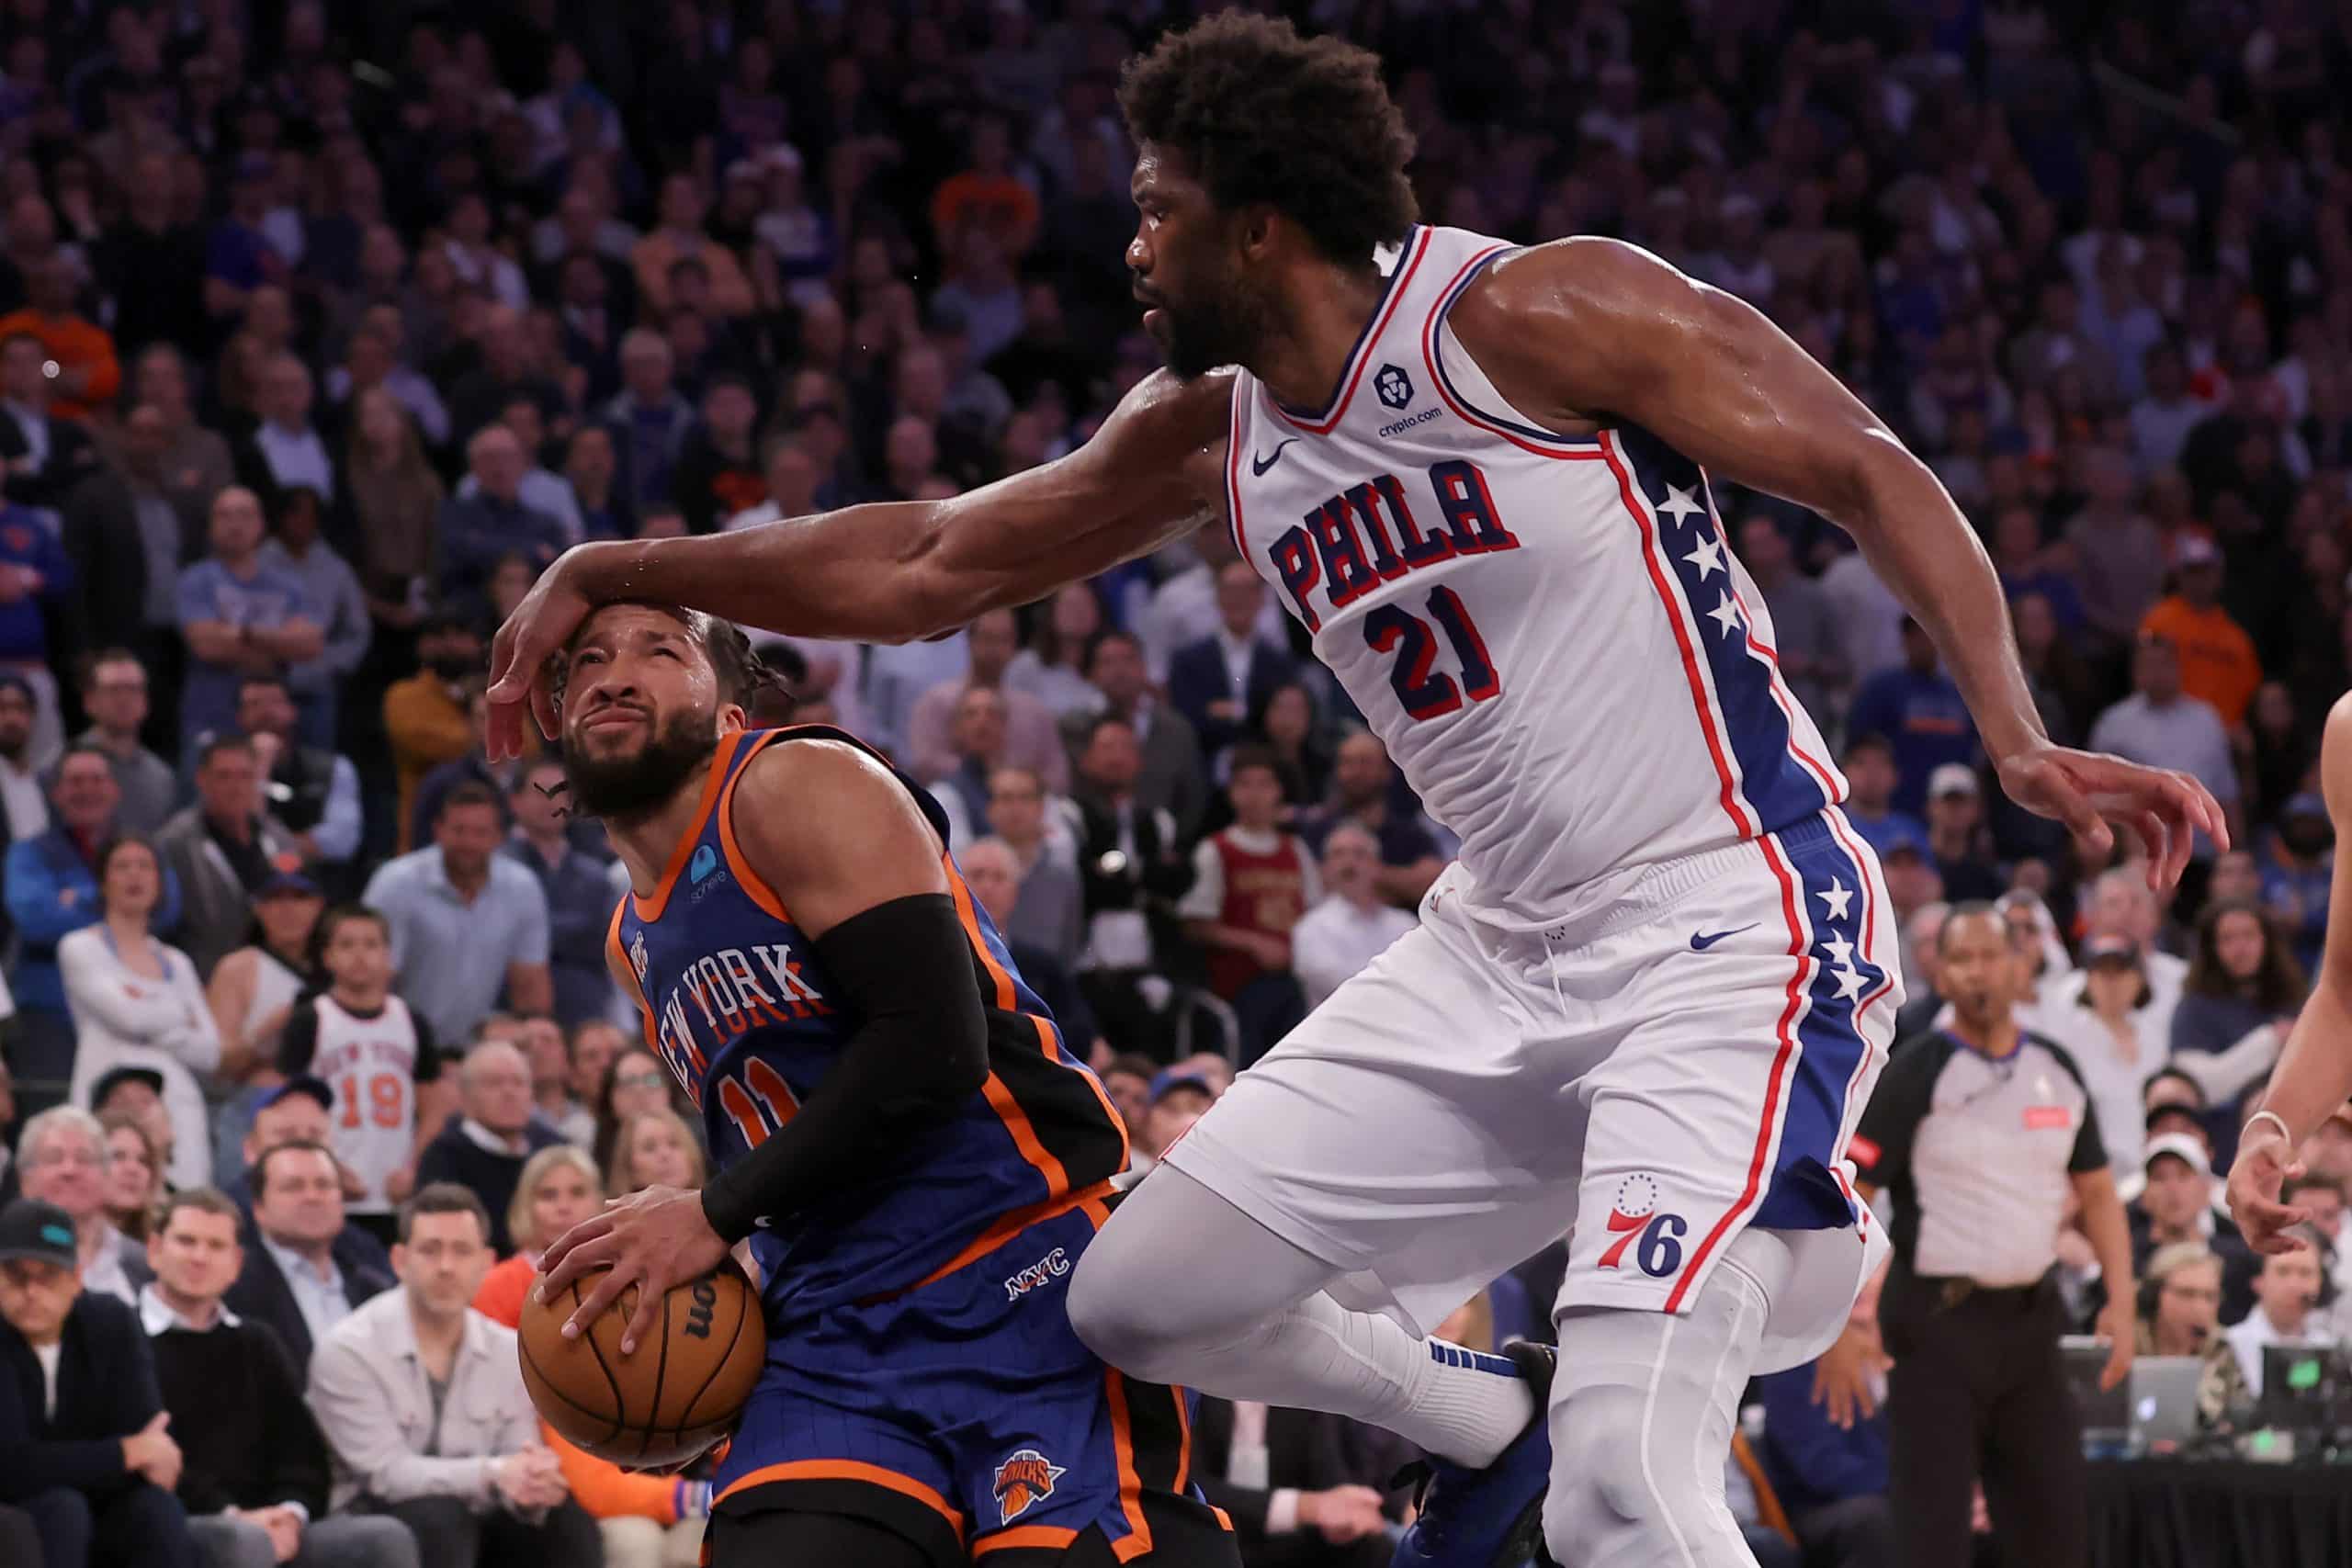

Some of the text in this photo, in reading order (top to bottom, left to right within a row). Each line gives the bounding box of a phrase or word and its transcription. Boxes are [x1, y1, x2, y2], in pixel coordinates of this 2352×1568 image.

[1379, 407, 1442, 437] crypto.com
[1269, 459, 1521, 634] PHILA
[1363, 584, 1500, 721] 21
[682, 943, 829, 1036] YORK
[340, 1073, 402, 1130] 19
[718, 1055, 802, 1151] 11
[1004, 1247, 1070, 1302] NYC
[1598, 1208, 1687, 1277] 76
